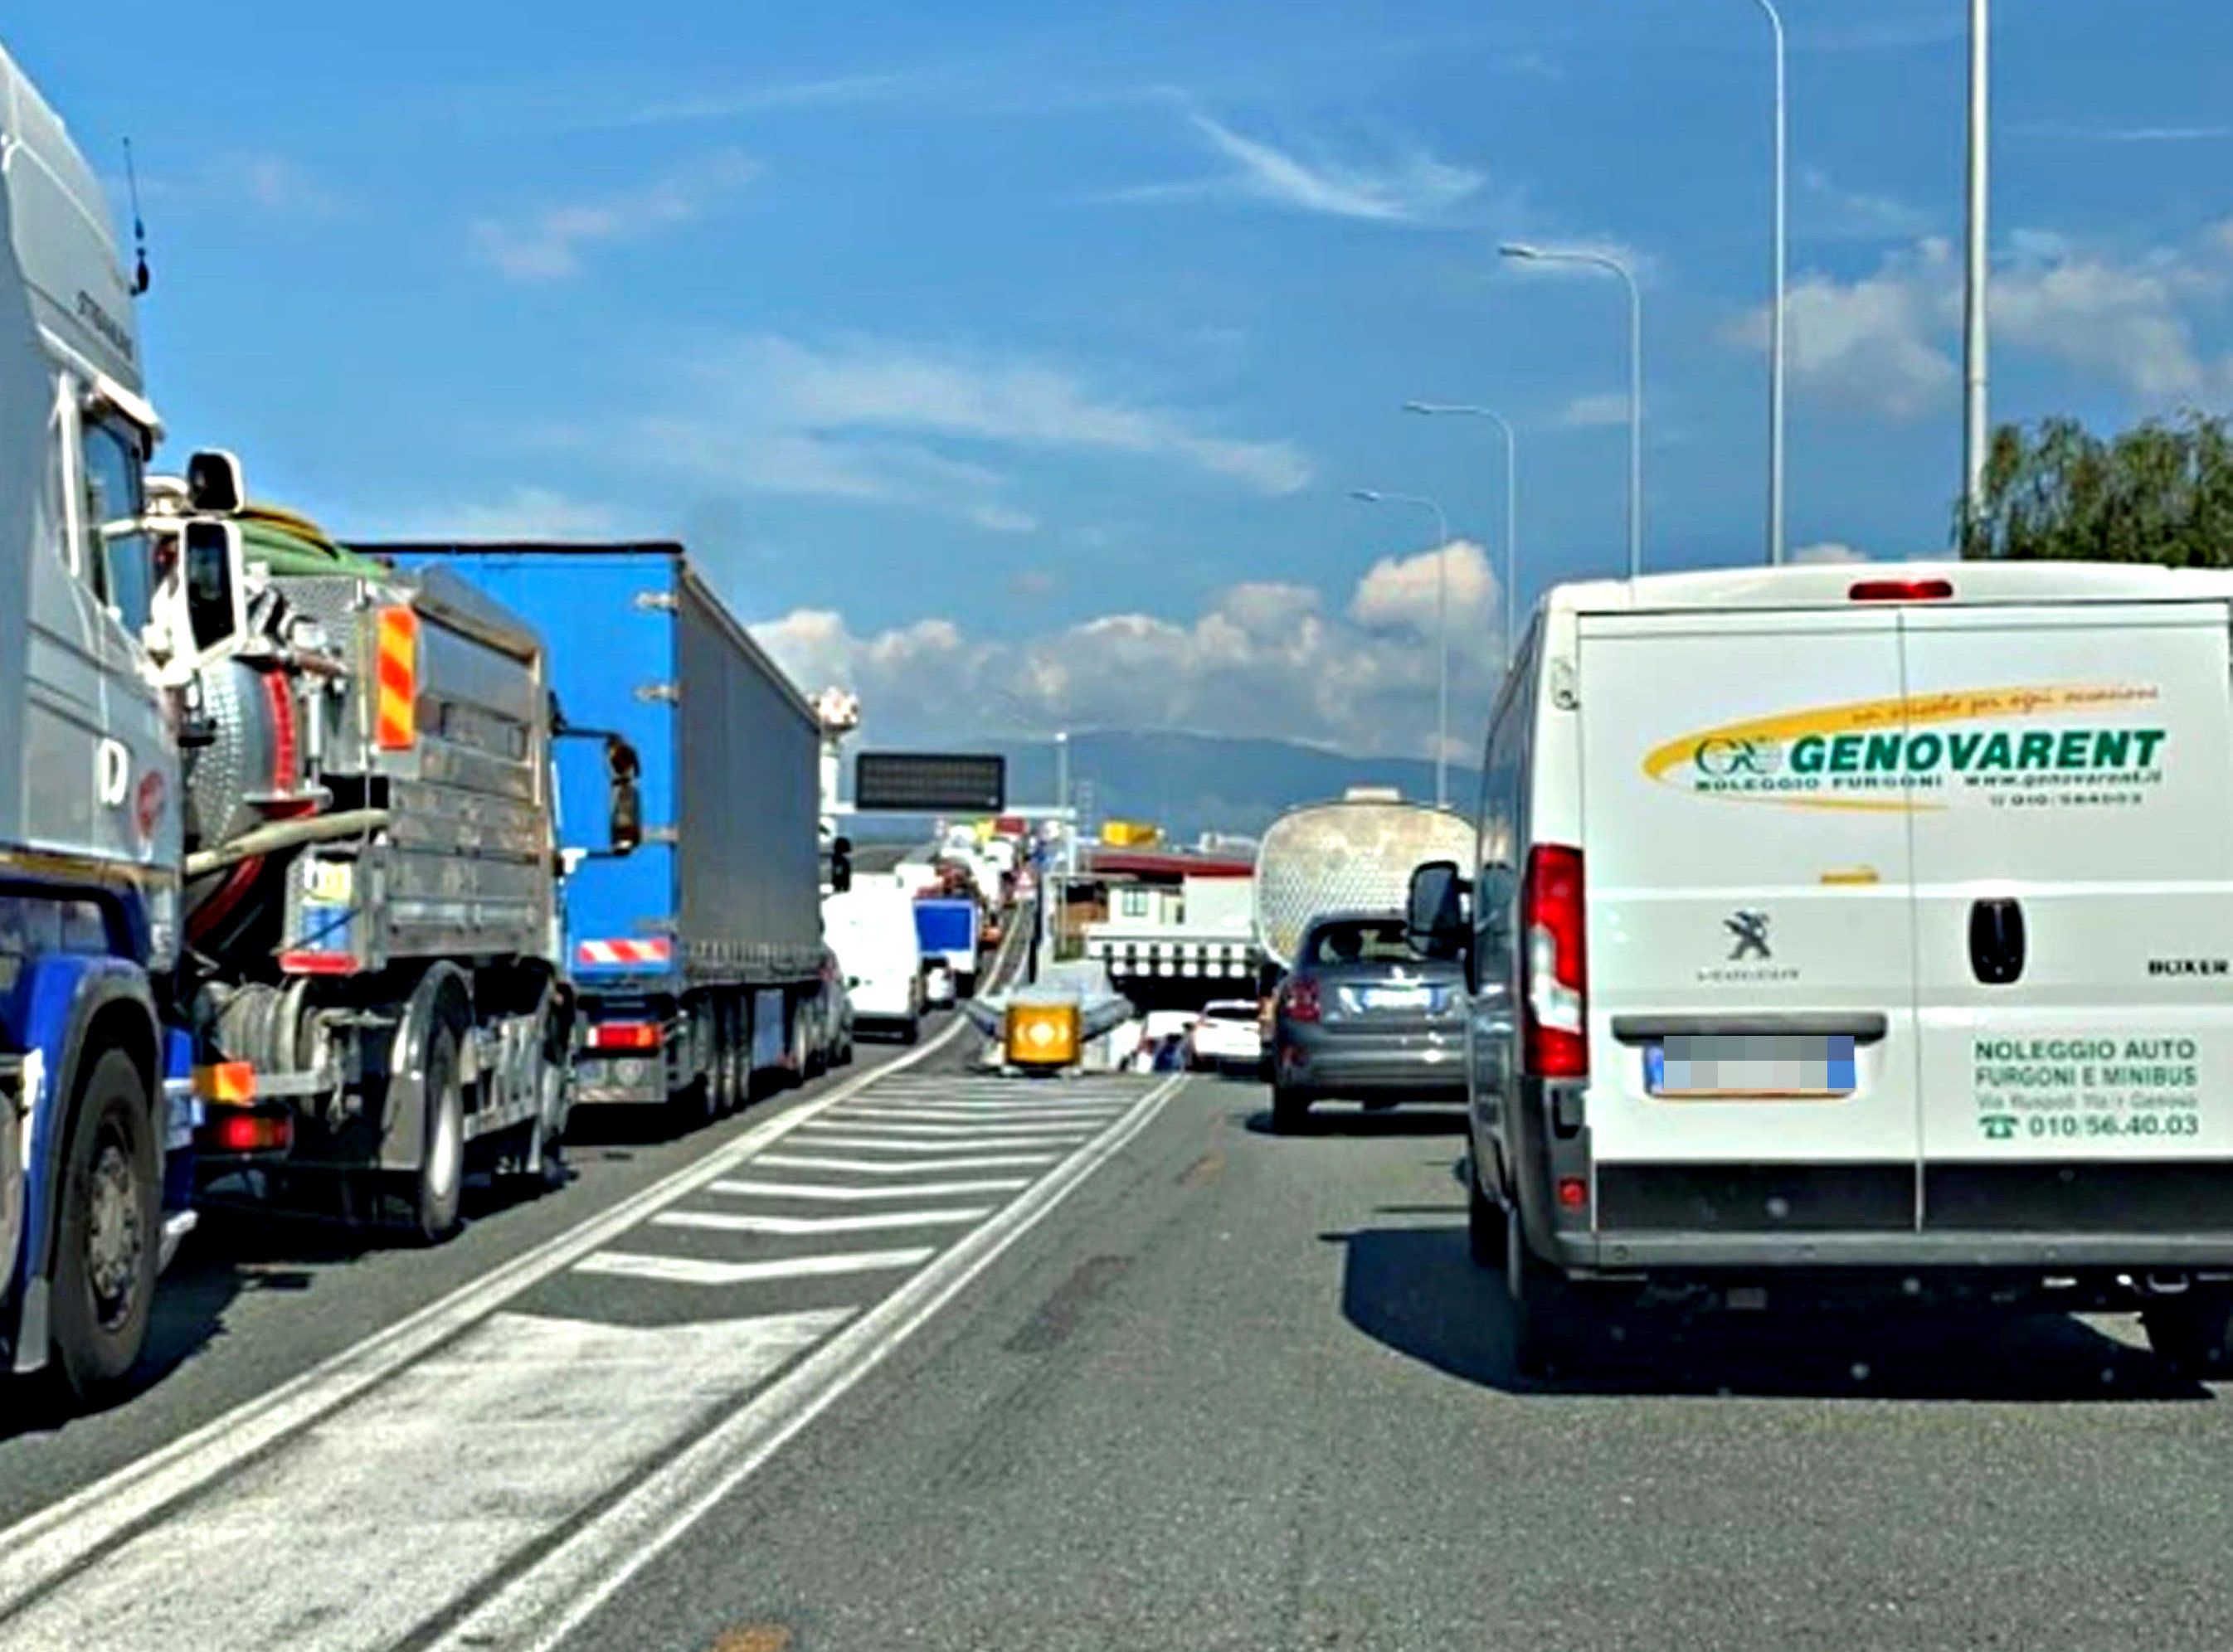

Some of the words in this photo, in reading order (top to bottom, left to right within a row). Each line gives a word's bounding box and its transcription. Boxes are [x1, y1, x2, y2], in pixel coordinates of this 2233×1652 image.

[1790, 730, 2165, 771] GENOVARENT
[1695, 777, 1819, 791] NOLEGGIO
[1832, 774, 1942, 789] FURGONI
[1975, 1040, 2116, 1061] NOLEGGIO
[2124, 1040, 2197, 1060] AUTO
[1976, 1067, 2075, 1086] FURGONI
[2083, 1067, 2095, 1086] E
[2102, 1067, 2196, 1086] MINIBUS
[2029, 1115, 2077, 1136] 010
